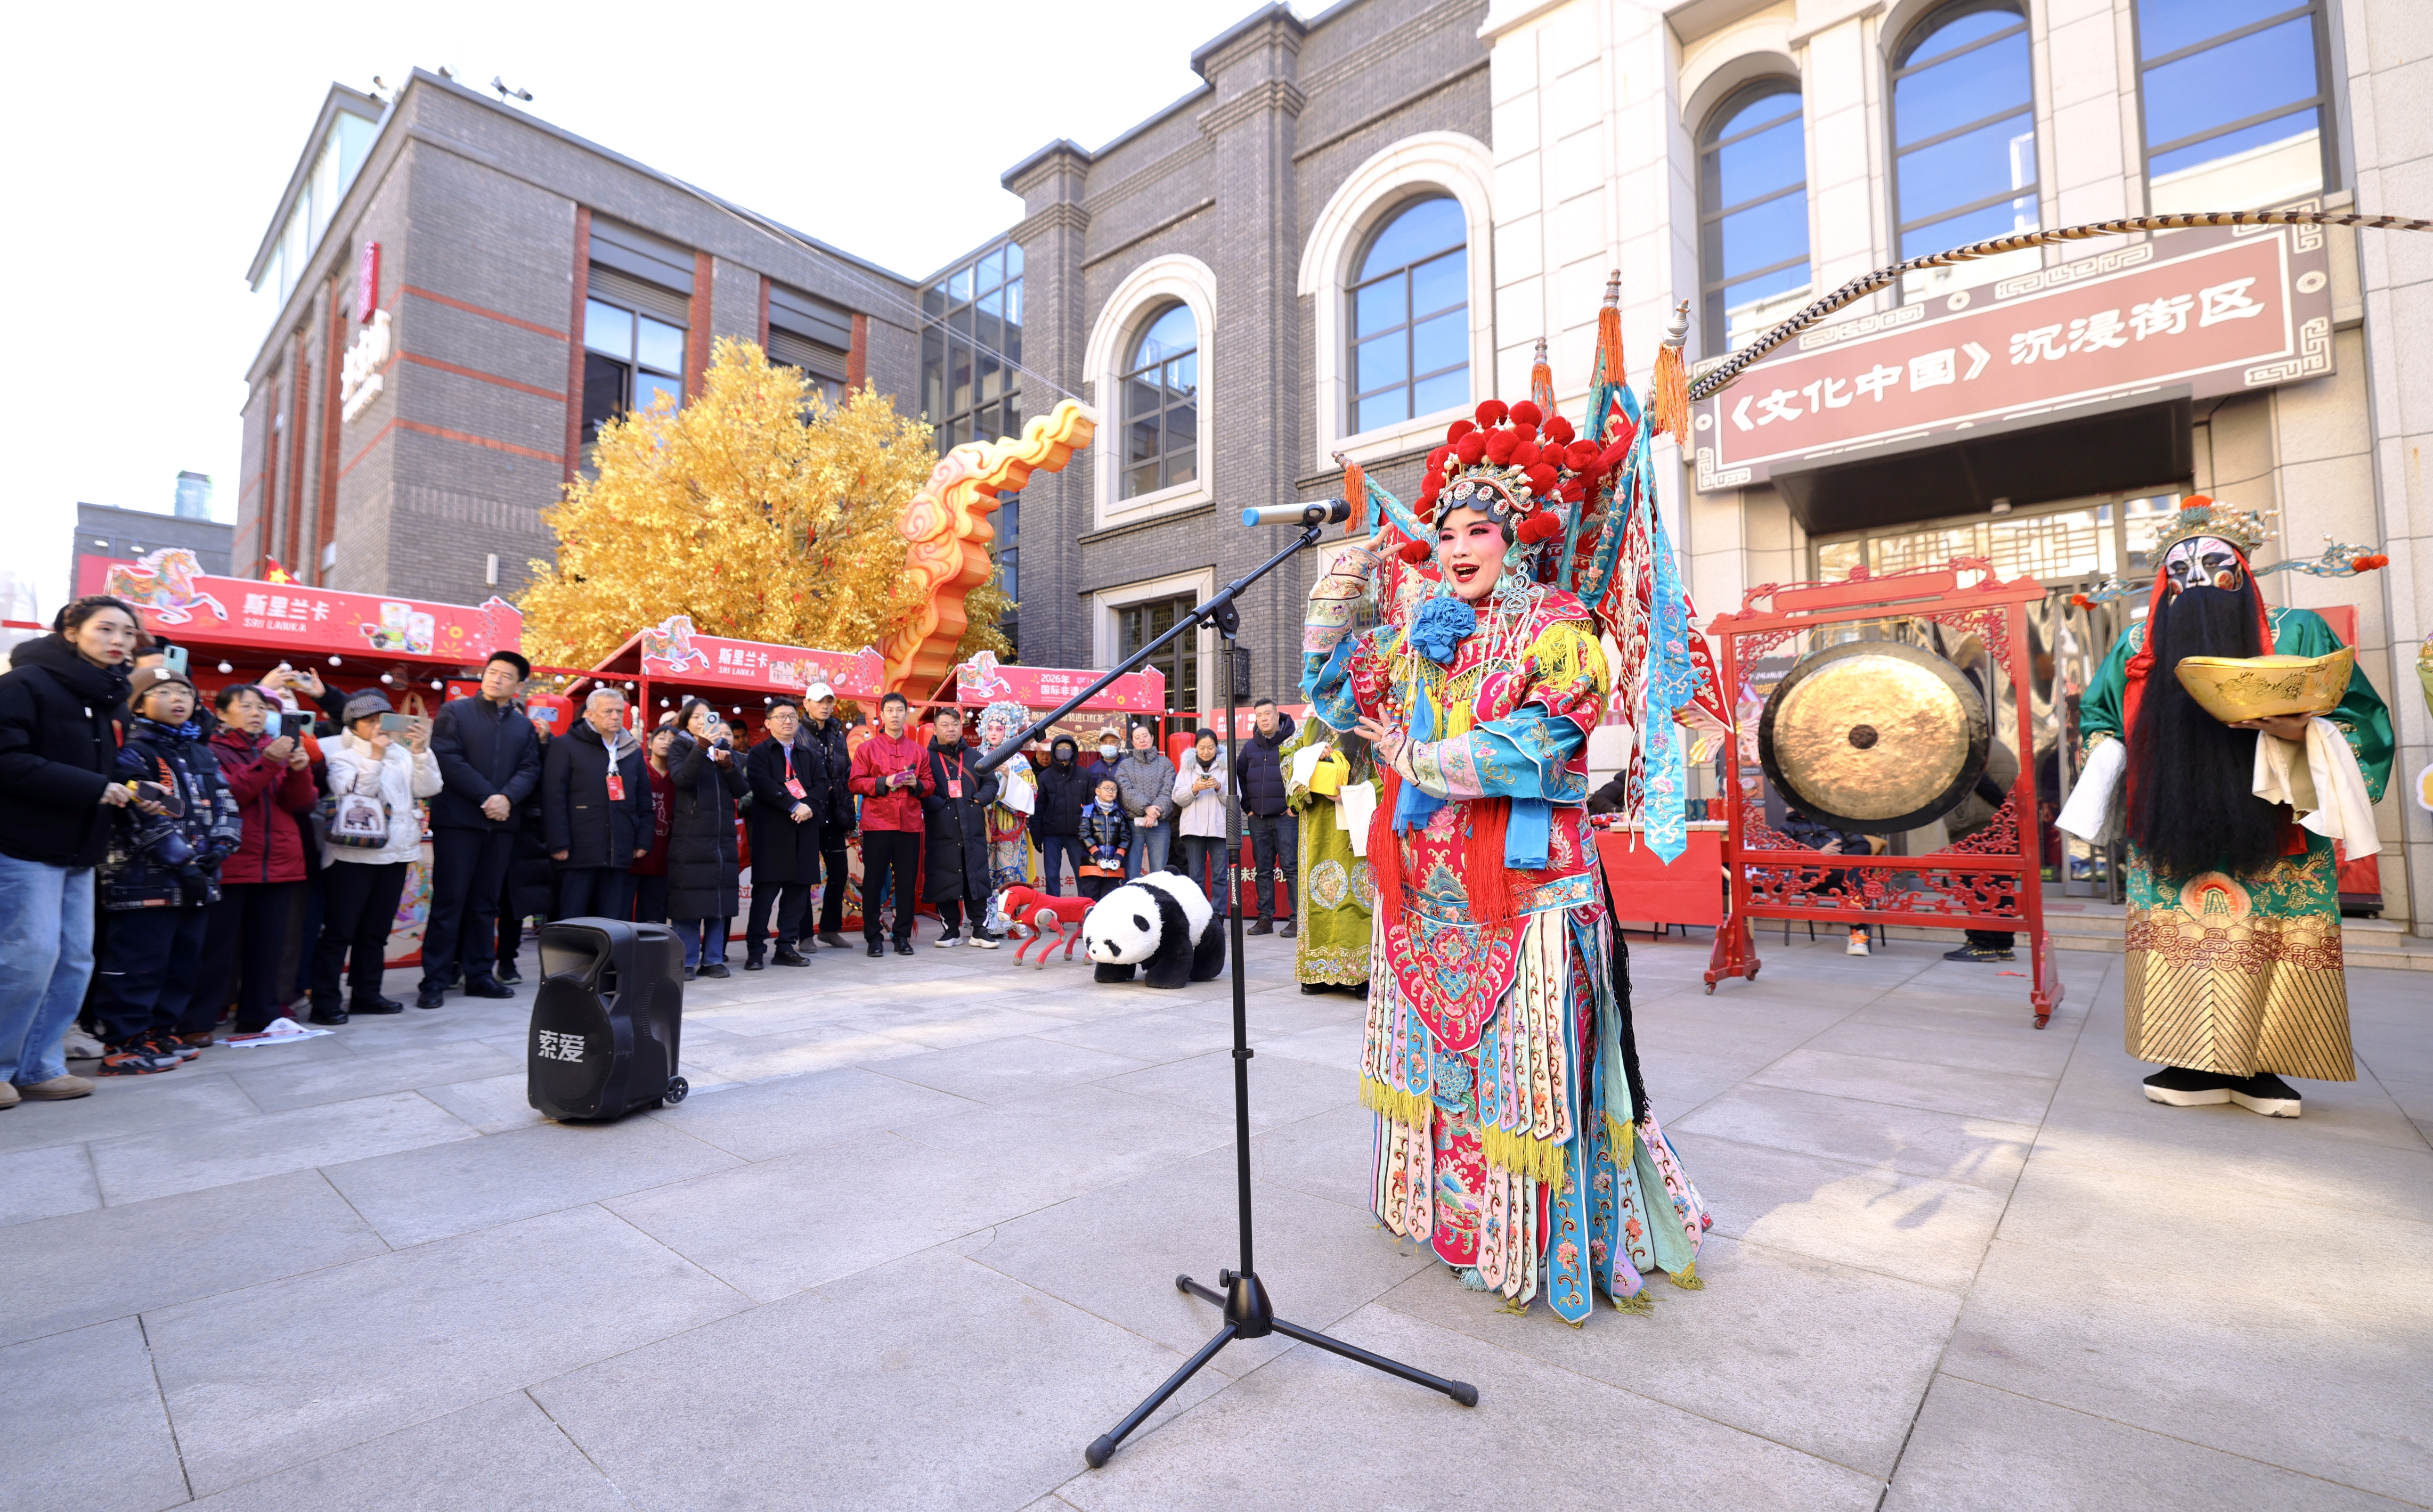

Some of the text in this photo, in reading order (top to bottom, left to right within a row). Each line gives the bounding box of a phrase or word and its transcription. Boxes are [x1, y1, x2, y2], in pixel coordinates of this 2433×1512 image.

[242, 592, 330, 622] 斯里兰卡
[242, 617, 307, 633] SRI LANKA
[718, 647, 769, 668] 斯里兰卡
[718, 666, 755, 677] SRI LANKA
[1040, 673, 1070, 685] 2026年
[1040, 684, 1109, 698] 国际非遗年
[1031, 711, 1105, 724] 斯里原装进口红茶
[538, 1029, 585, 1063] 索爱
